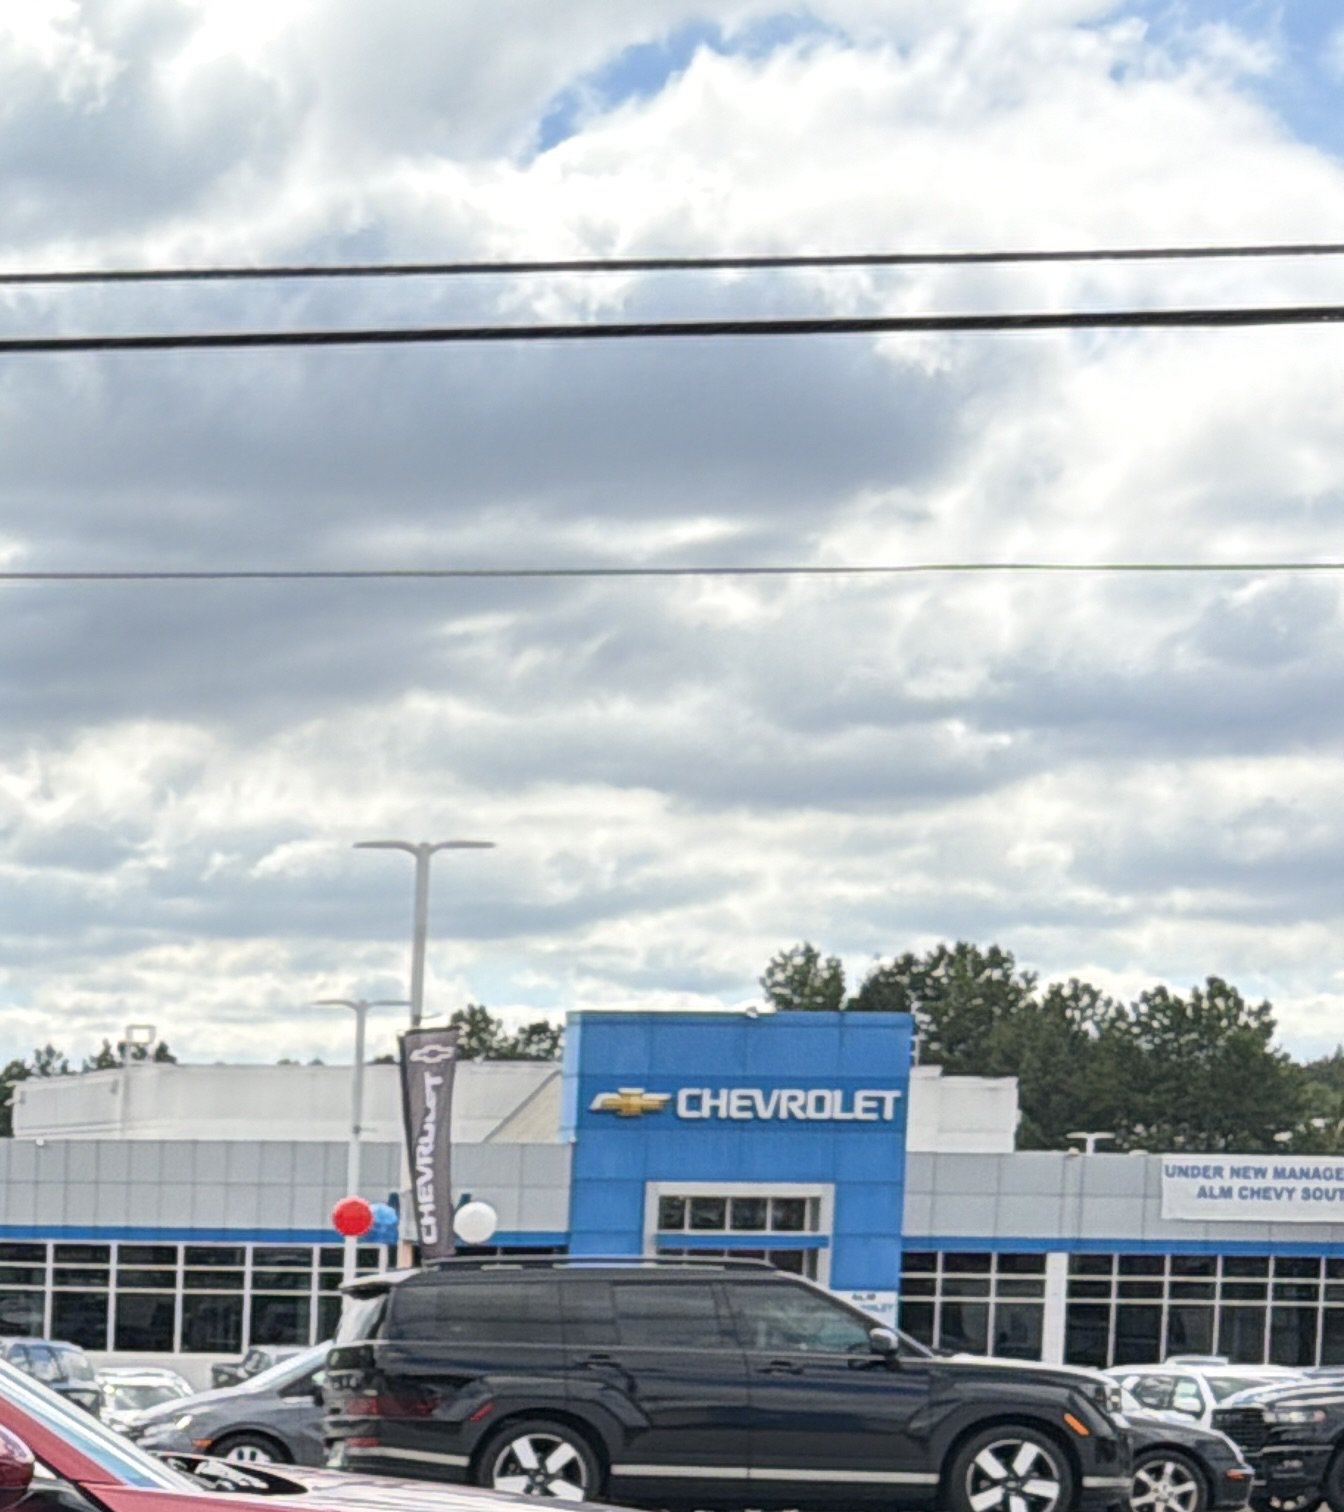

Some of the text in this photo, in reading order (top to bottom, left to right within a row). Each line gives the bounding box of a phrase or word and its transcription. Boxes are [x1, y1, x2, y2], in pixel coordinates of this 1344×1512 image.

[677, 1087, 902, 1121] CHEVROLET
[1164, 1164, 1224, 1180] UNDER
[1229, 1165, 1268, 1180] NEW
[1196, 1185, 1233, 1199] ALM
[1237, 1186, 1296, 1202] CHEVY
